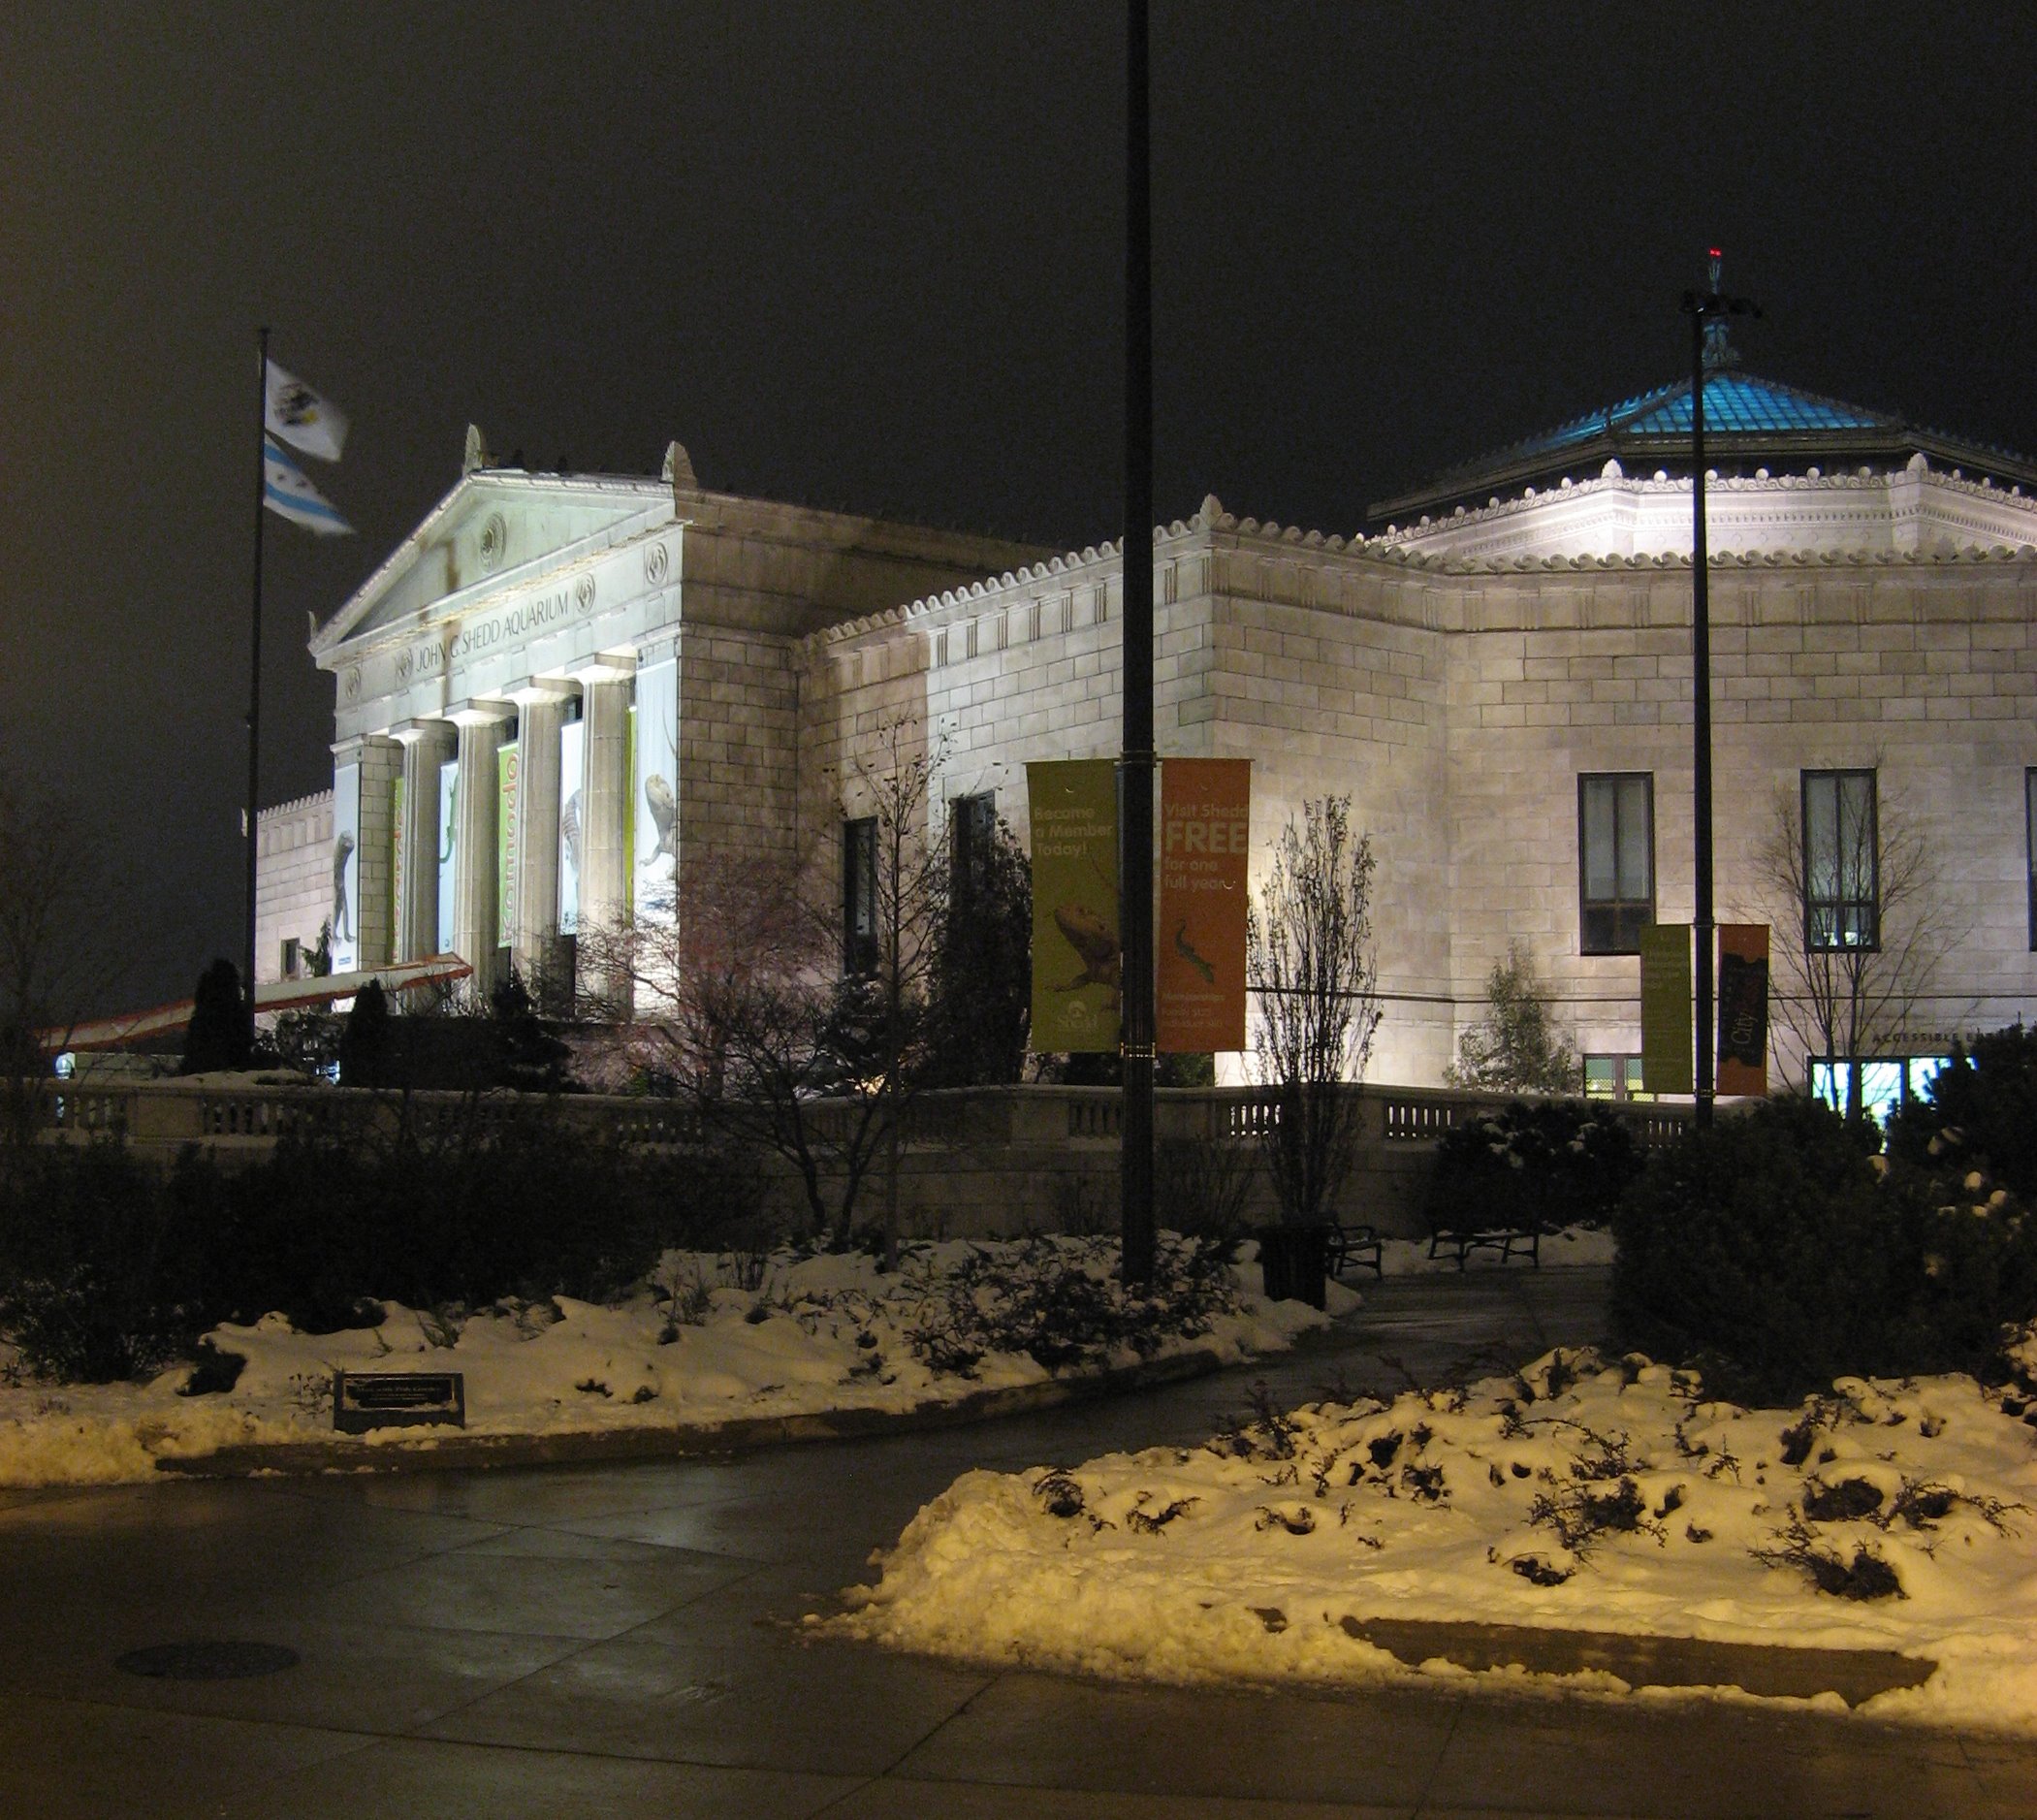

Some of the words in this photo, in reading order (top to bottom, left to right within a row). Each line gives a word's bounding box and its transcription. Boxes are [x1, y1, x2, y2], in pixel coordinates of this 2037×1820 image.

[416, 643, 446, 673] JOHN
[462, 618, 500, 655] SHEDD
[503, 591, 569, 637] AQUARIUM
[1034, 806, 1097, 820] Become
[1163, 803, 1197, 818] Visit
[1200, 803, 1248, 818] Shedd
[1034, 827, 1044, 838] a
[1049, 821, 1114, 838] Member
[1165, 820, 1248, 853] FREE
[1035, 841, 1087, 858] Today!
[1164, 855, 1186, 871] for
[1189, 860, 1219, 872] one
[1164, 875, 1187, 889] full
[1872, 1032, 1959, 1043] ACCESSIBLE
